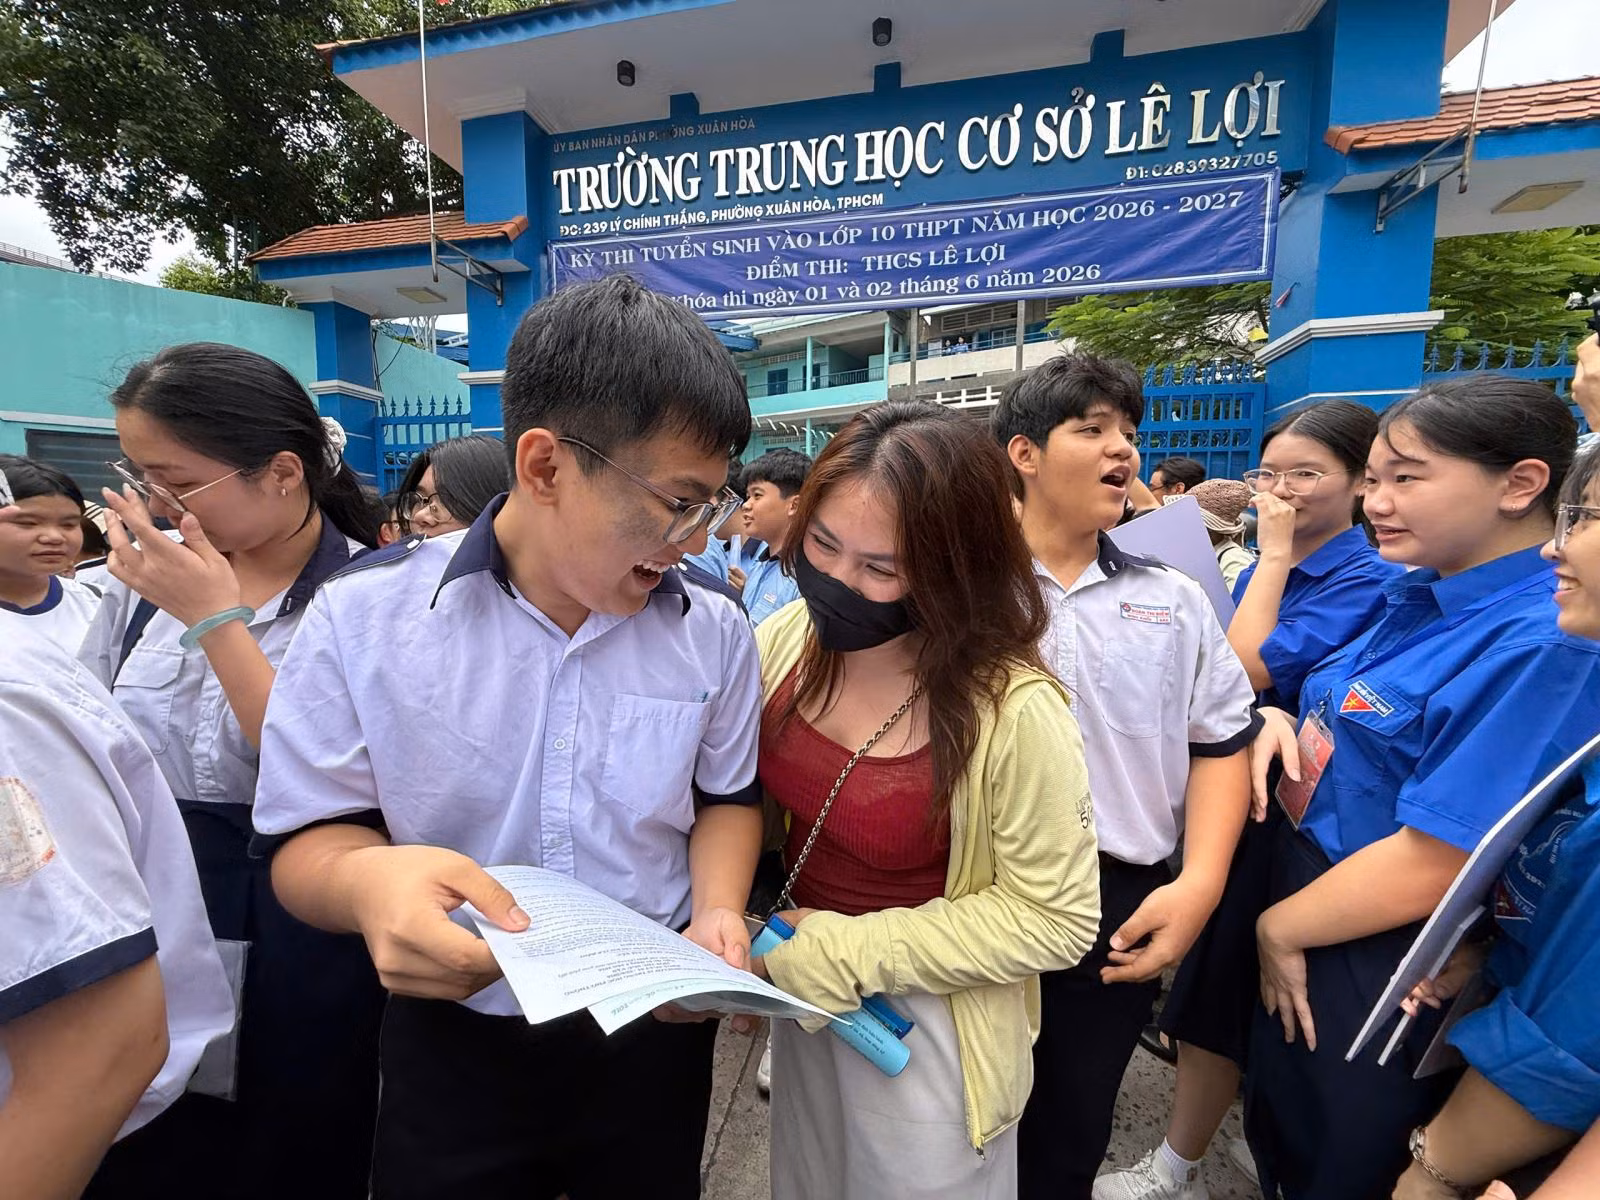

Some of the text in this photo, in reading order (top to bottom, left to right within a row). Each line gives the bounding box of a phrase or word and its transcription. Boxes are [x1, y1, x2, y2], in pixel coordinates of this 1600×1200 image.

[553, 70, 1285, 214] TRƯỜNG TRUNG HỌC CƠ SỞ LÊ LỢI
[568, 140, 589, 151] BAN
[591, 133, 621, 149] NHÂN
[623, 130, 646, 145] DÂN
[697, 119, 728, 135] XUÂN
[730, 115, 755, 131] HÒA
[560, 193, 883, 236] ĐC: 239 LÝ CHÍNH THẮNG, PHƯỜNG XUÂN HÒA, TPHCM
[570, 249, 596, 268] KỲ
[601, 249, 634, 265] THI
[639, 235, 707, 262] TUYỂN
[712, 237, 761, 256] SINH
[766, 229, 813, 251] VÀO
[818, 225, 862, 247] LỚP
[871, 226, 895, 242] 10
[902, 218, 964, 239] THPT
[971, 210, 1025, 233] NĂM
[1032, 206, 1086, 230] HỌC
[1093, 200, 1155, 222] 2026
[1179, 191, 1245, 213] 2027
[746, 242, 1006, 281] ĐIỂM THI: THCS LÊ LỢI
[722, 289, 747, 307] thi
[752, 285, 800, 307] ngày
[805, 286, 828, 301] 01
[837, 281, 861, 299] và
[866, 281, 892, 297] 02
[899, 275, 960, 296] tháng
[965, 274, 980, 289] 6
[986, 268, 1034, 288] năm
[1042, 264, 1101, 284] 2026
